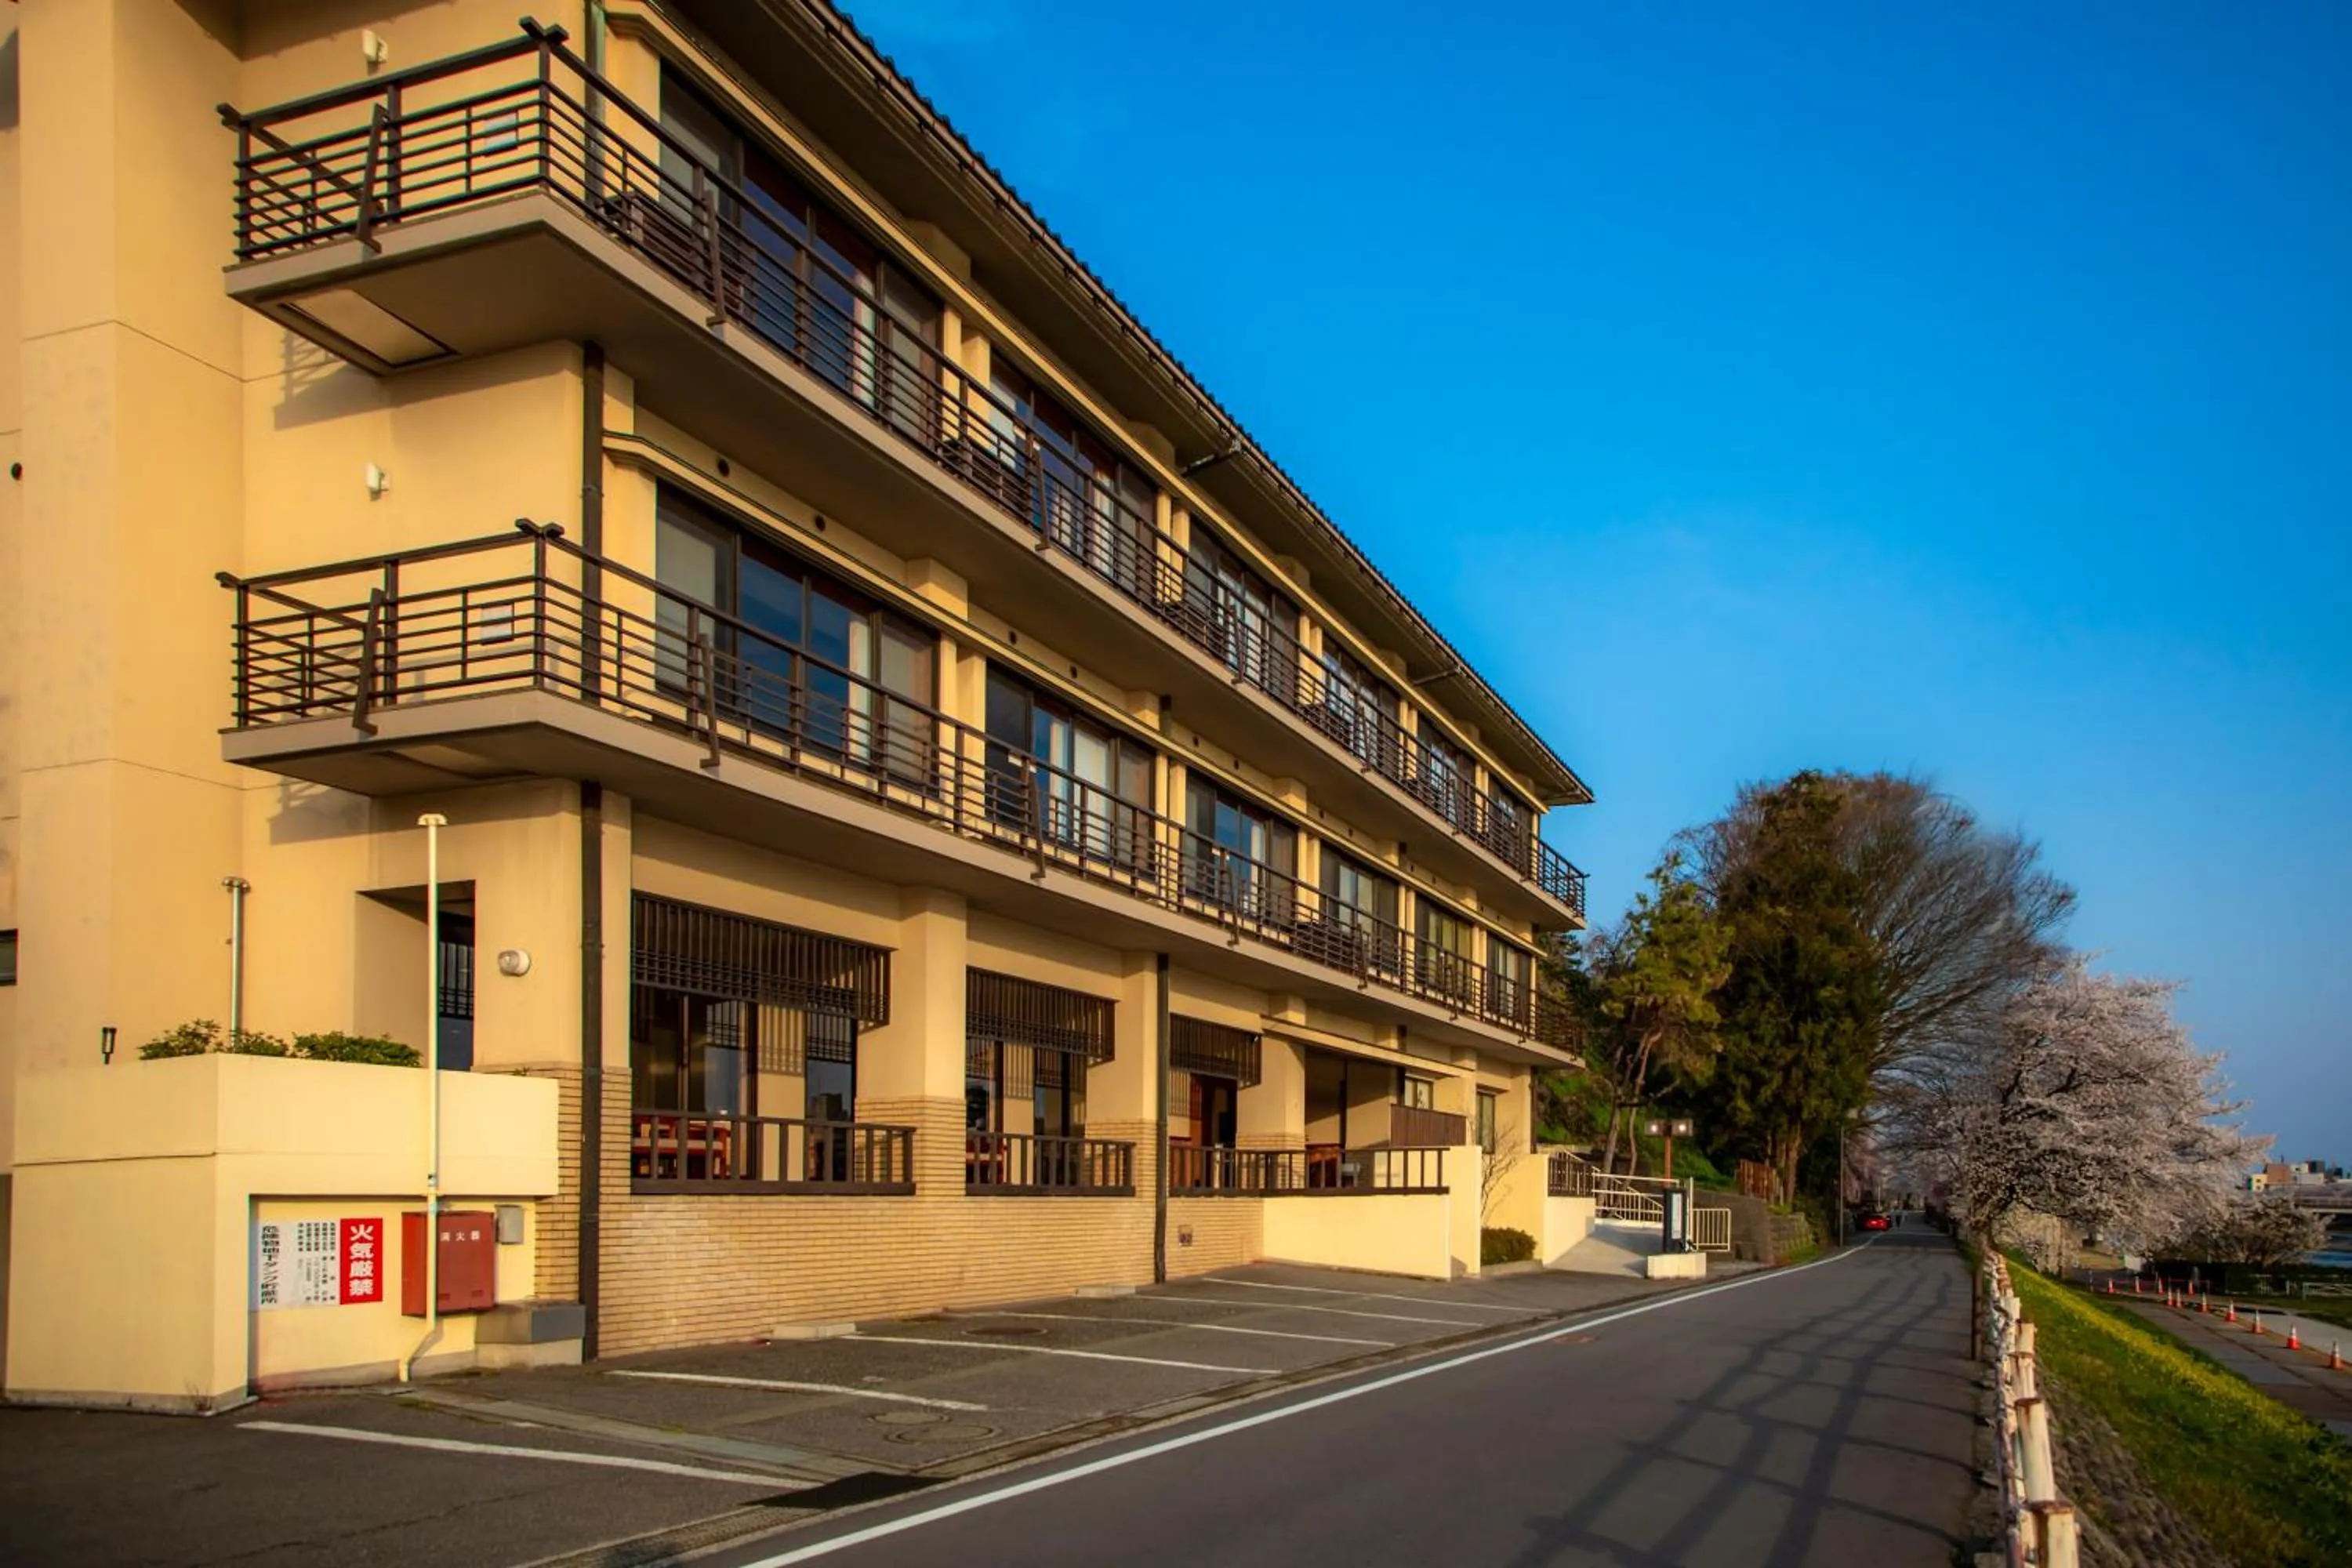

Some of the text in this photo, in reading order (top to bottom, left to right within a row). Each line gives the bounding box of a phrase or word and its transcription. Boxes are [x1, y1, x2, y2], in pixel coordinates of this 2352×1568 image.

[440, 1230, 480, 1242] 消火器
[350, 1224, 374, 1296] 火気厳禁
